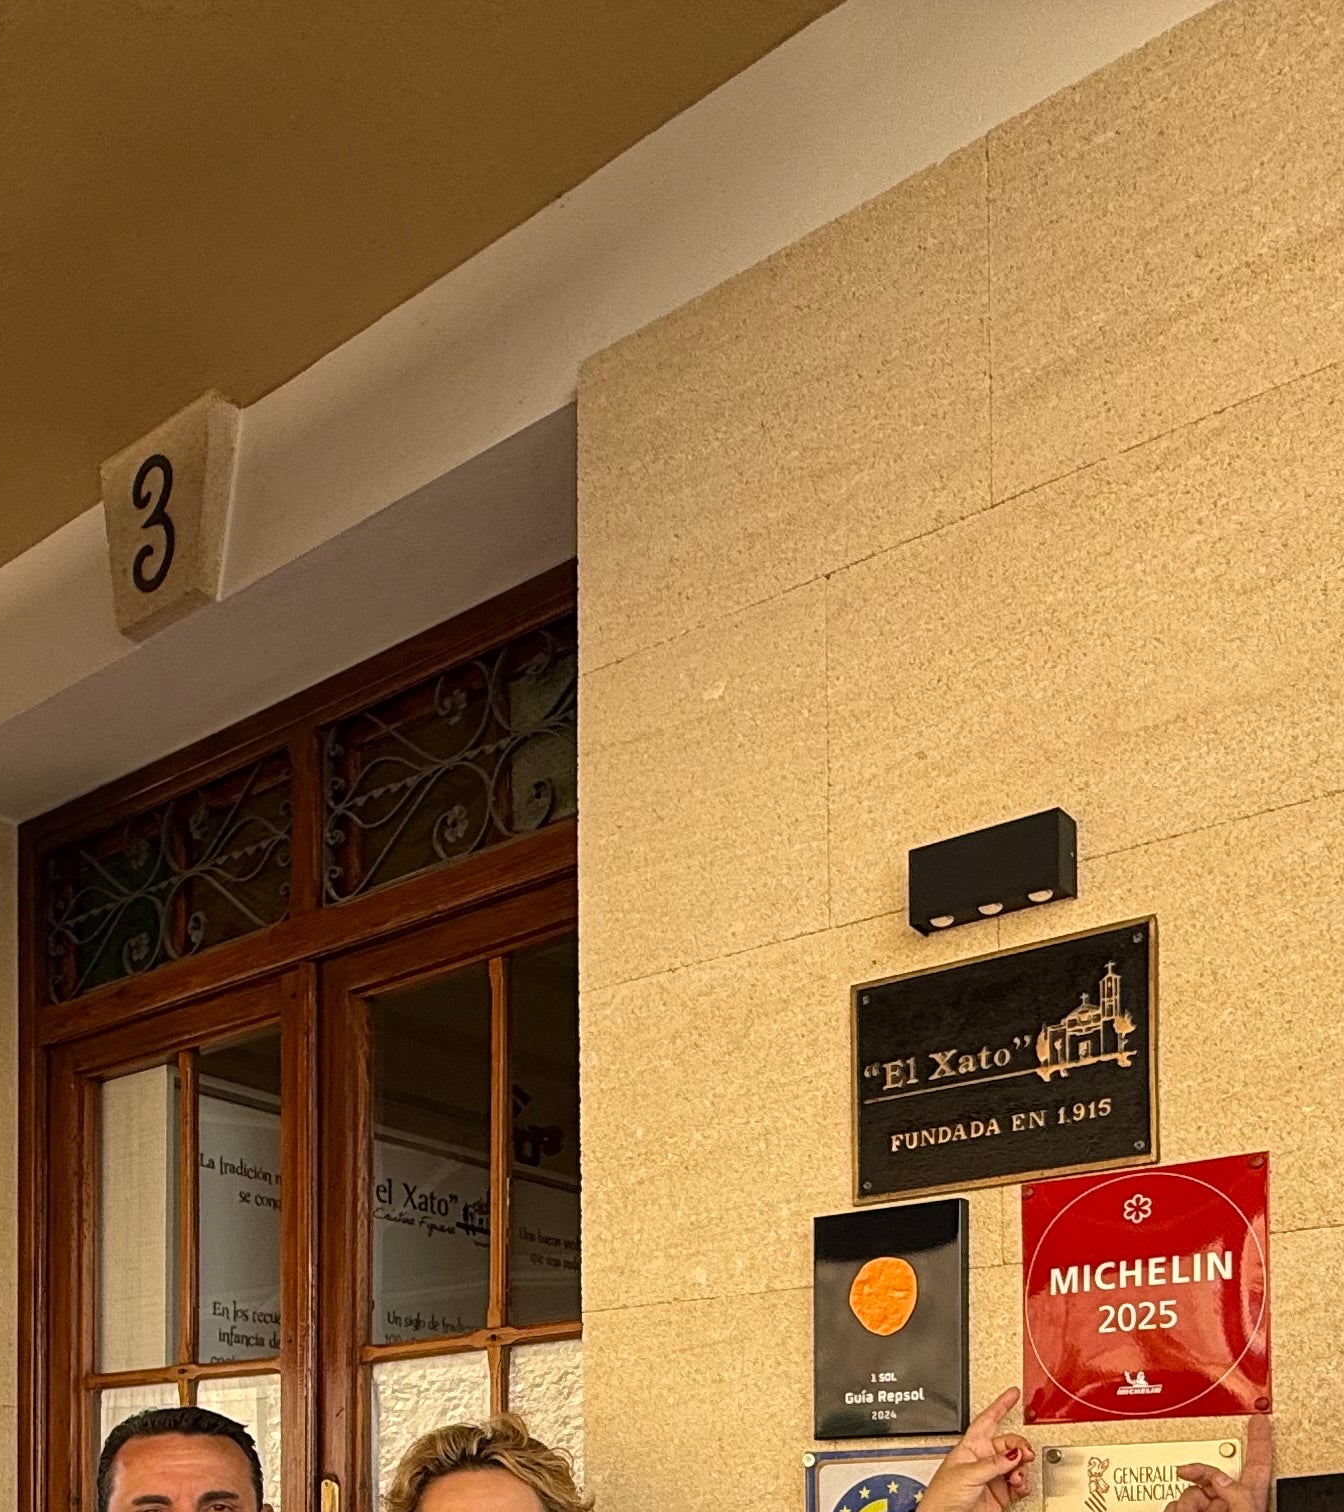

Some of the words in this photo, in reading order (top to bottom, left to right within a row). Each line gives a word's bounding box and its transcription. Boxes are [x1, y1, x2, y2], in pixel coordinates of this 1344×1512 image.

[132, 453, 175, 593] 3
[863, 1056, 919, 1090] “El
[928, 1034, 1032, 1081] Xato”
[890, 1118, 1001, 1152] FUNDADA
[1011, 1109, 1048, 1132] EN
[200, 1153, 216, 1169] La
[1050, 1250, 1233, 1296] MICHELIN
[213, 1301, 229, 1320] En
[1098, 1299, 1178, 1334] 2025
[870, 1373, 877, 1383] 1
[878, 1372, 898, 1383] SOL
[844, 1388, 874, 1405] Guía
[878, 1387, 925, 1405] Repsol
[871, 1410, 898, 1421] 2024
[1113, 1465, 1179, 1485] GENERALI
[1114, 1482, 1188, 1502] VALENCIAN
